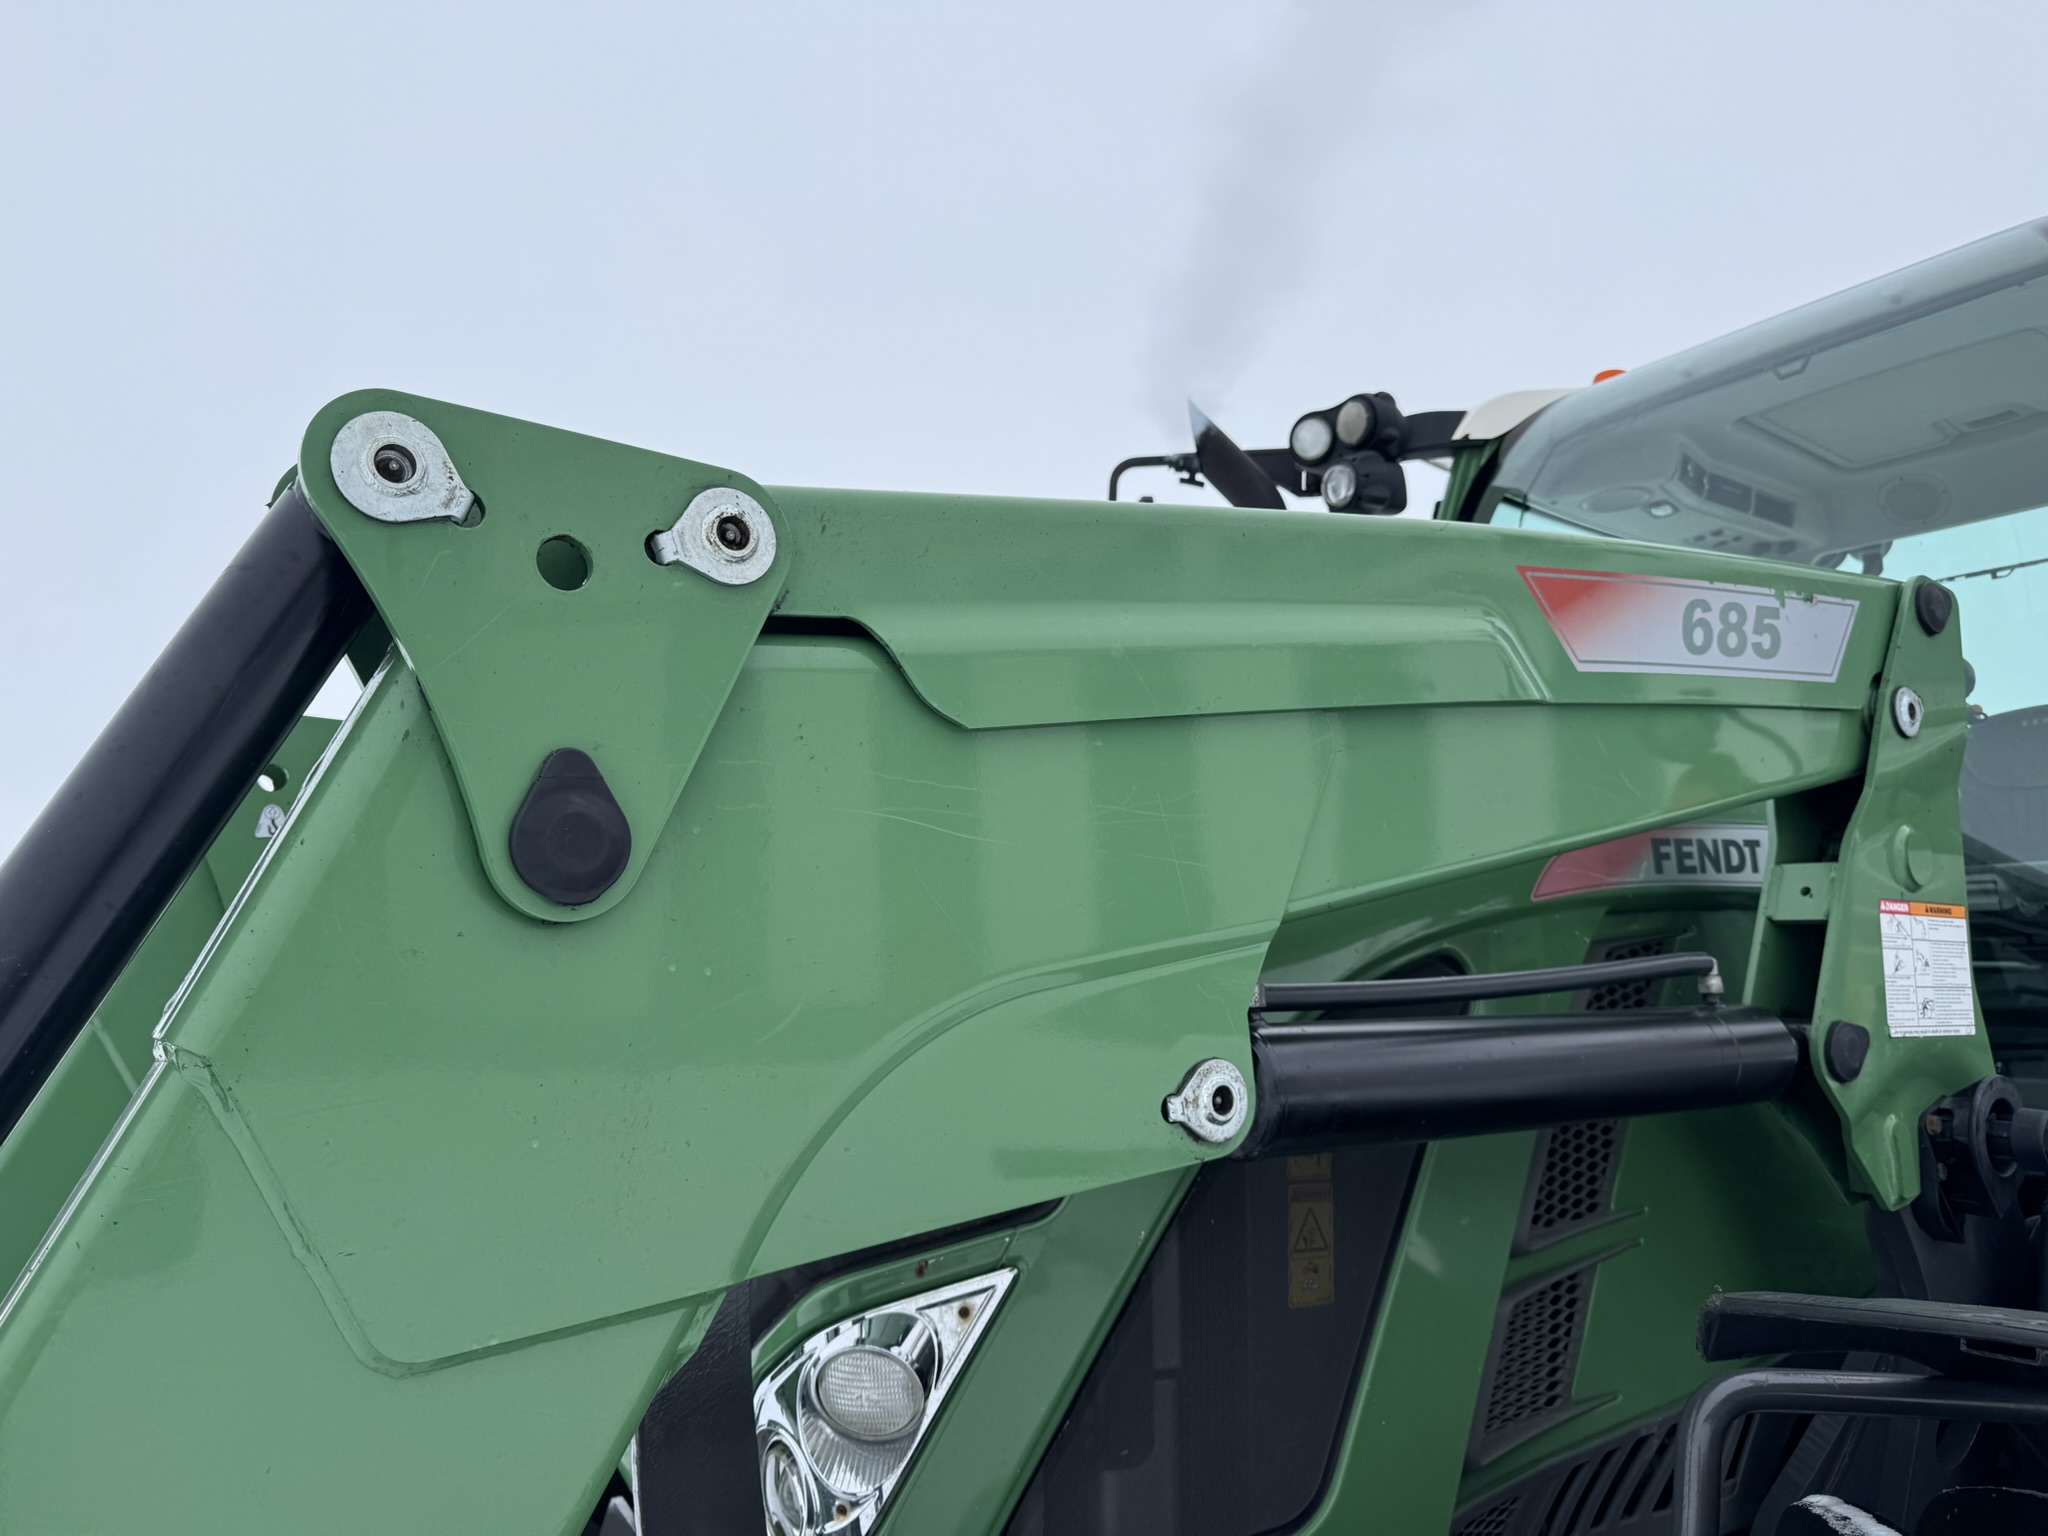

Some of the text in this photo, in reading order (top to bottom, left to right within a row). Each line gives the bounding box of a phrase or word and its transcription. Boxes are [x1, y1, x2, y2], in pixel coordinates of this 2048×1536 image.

[1682, 598, 1782, 660] 685
[1650, 837, 1761, 875] FENDT
[1885, 901, 1909, 913] DANGER
[1929, 907, 1953, 915] WARNING
